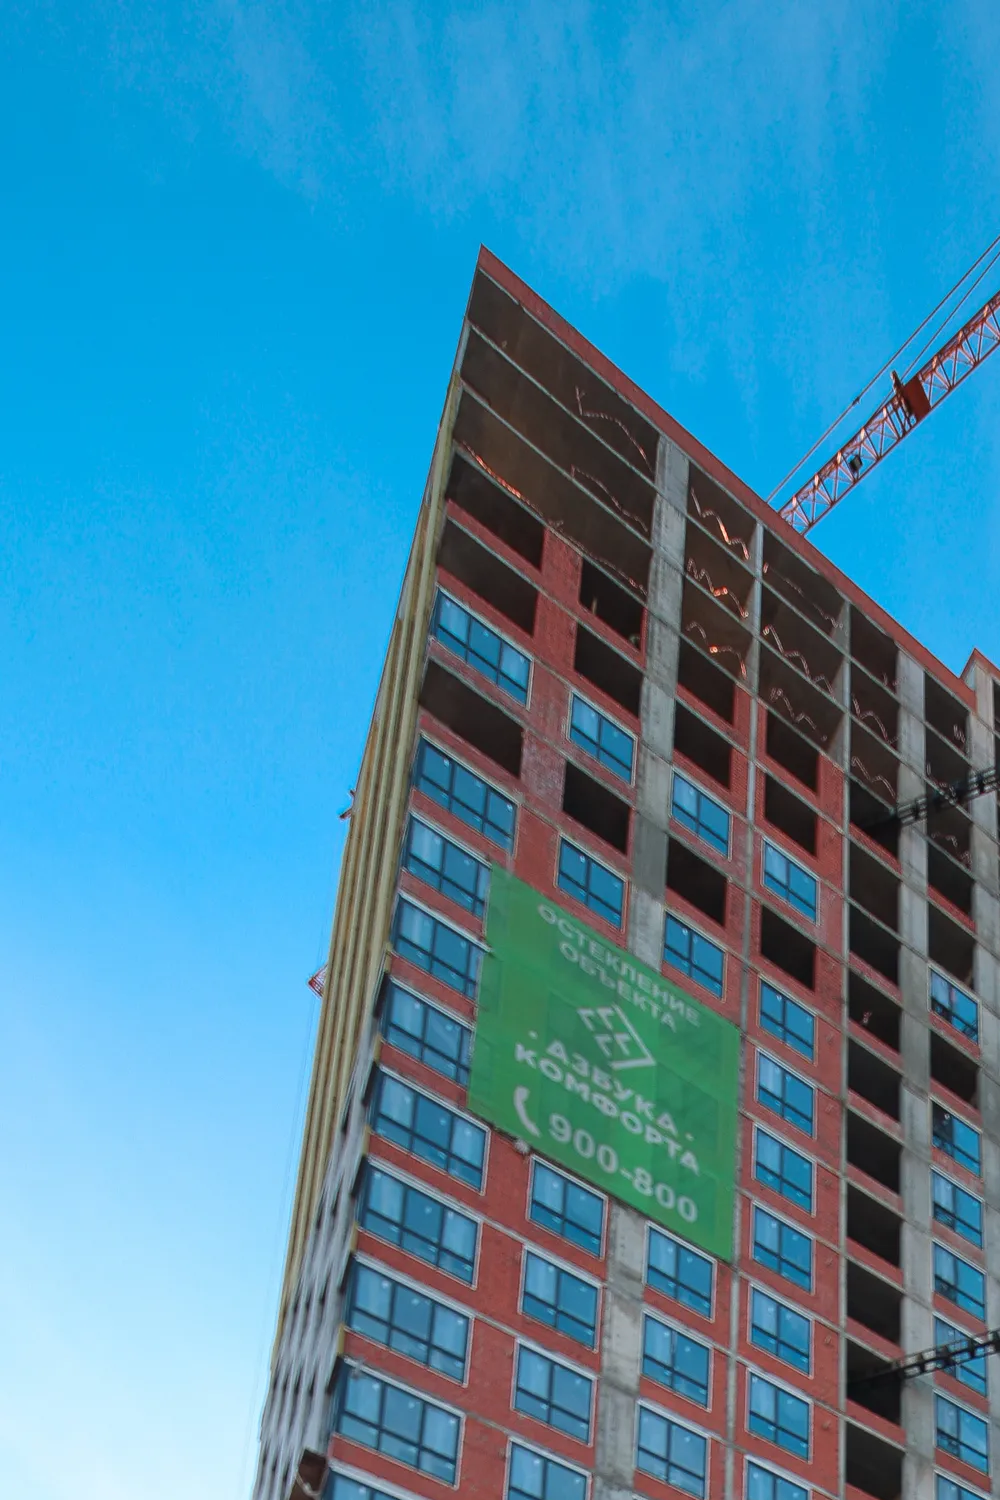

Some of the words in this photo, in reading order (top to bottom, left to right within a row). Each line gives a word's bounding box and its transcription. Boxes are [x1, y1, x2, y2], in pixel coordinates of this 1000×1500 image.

[537, 903, 699, 1027] ОСТЕКЛЕНИЕ
[560, 941, 678, 1032] ОБЪЕКТА
[515, 1042, 700, 1175] КОМФОРТА
[545, 1040, 678, 1134] АЗБУКА
[548, 1113, 698, 1223] 900-800
